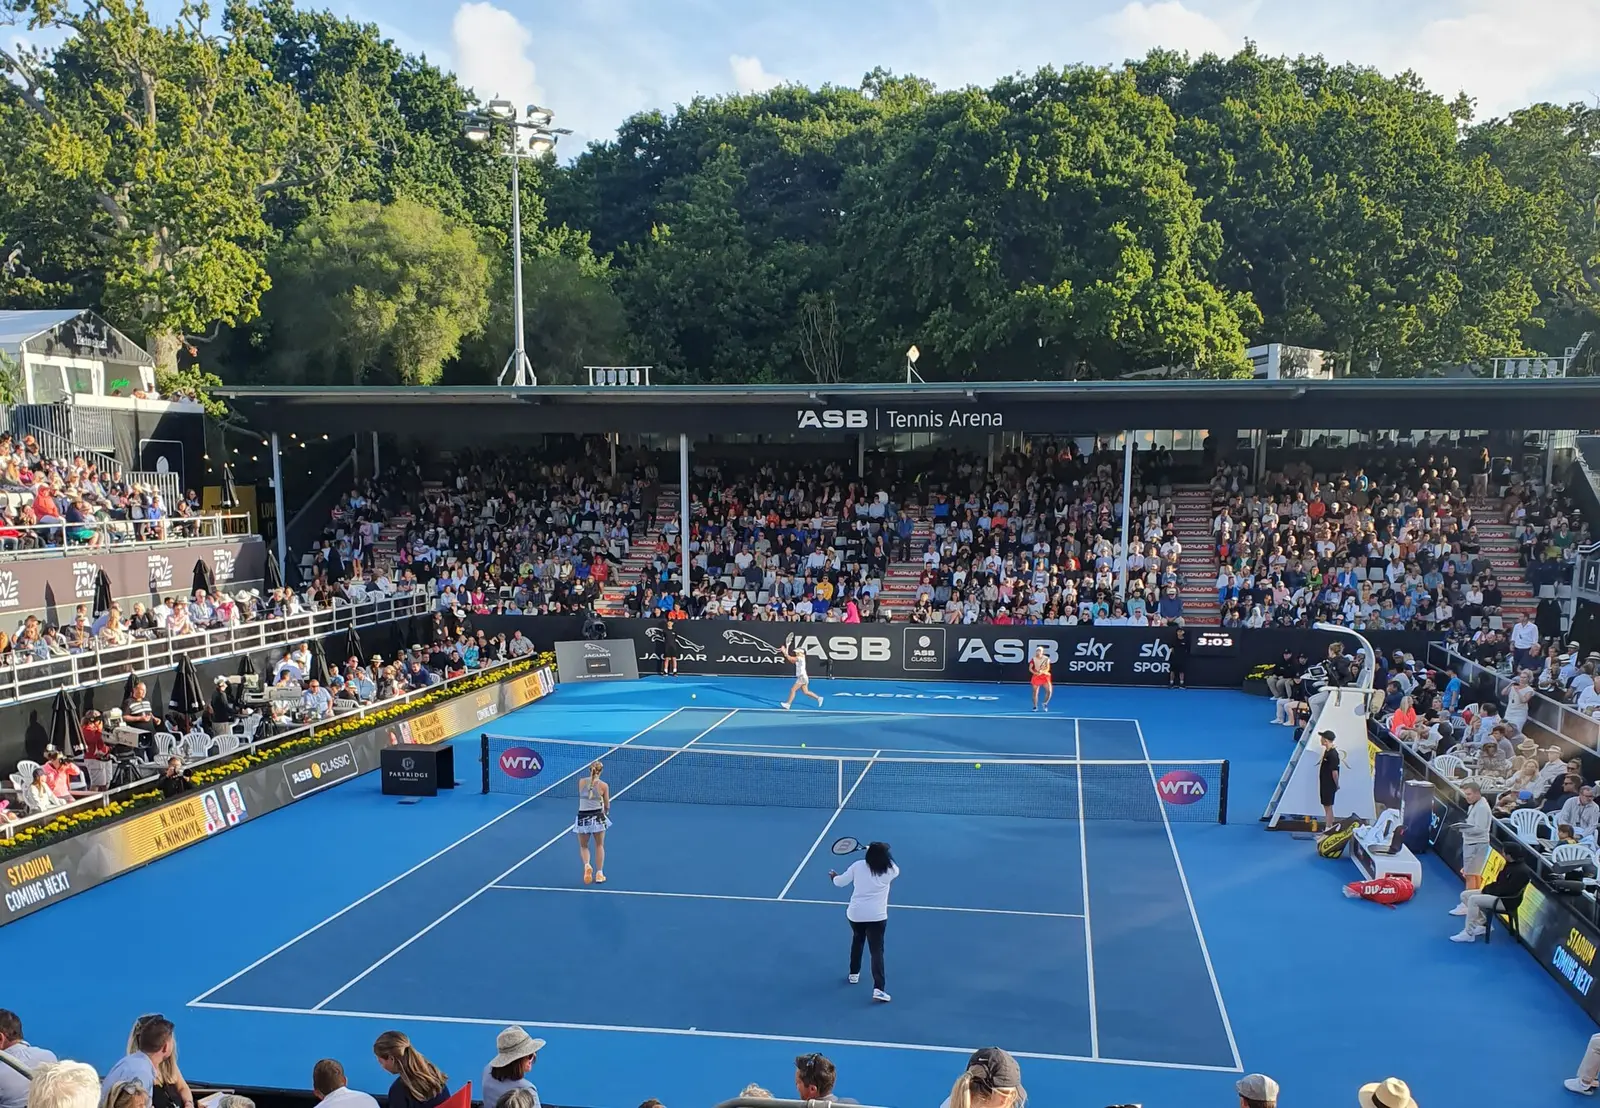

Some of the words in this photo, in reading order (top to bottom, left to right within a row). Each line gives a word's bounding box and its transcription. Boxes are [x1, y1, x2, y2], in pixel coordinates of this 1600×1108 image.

[797, 410, 868, 428] ASB
[887, 410, 943, 428] Tennis
[949, 410, 1003, 427] Arena
[794, 636, 892, 662] ASB
[958, 638, 1059, 664] ASB
[1074, 638, 1113, 660] sky
[1139, 638, 1174, 661] sky
[1197, 638, 1233, 647] 3:03
[716, 655, 786, 664] JAGUAR
[1069, 661, 1114, 672] SPORT
[1134, 662, 1170, 673] SPOR
[832, 692, 999, 700] AUCKLAND
[292, 766, 313, 784] ASB
[320, 754, 350, 774] CLASSIC
[502, 756, 542, 770] WTA
[1160, 780, 1204, 795] WTA
[160, 814, 169, 828] N.
[170, 804, 196, 824] HIBINO
[154, 836, 166, 851] M.
[166, 822, 202, 848] NINOMIYA
[7, 854, 54, 886] STADIUM
[5, 881, 46, 912] COMING
[44, 872, 70, 898] NEXT
[1566, 927, 1597, 966] STADIUM
[1552, 945, 1579, 982] COMING
[1573, 966, 1594, 996] NEXT
